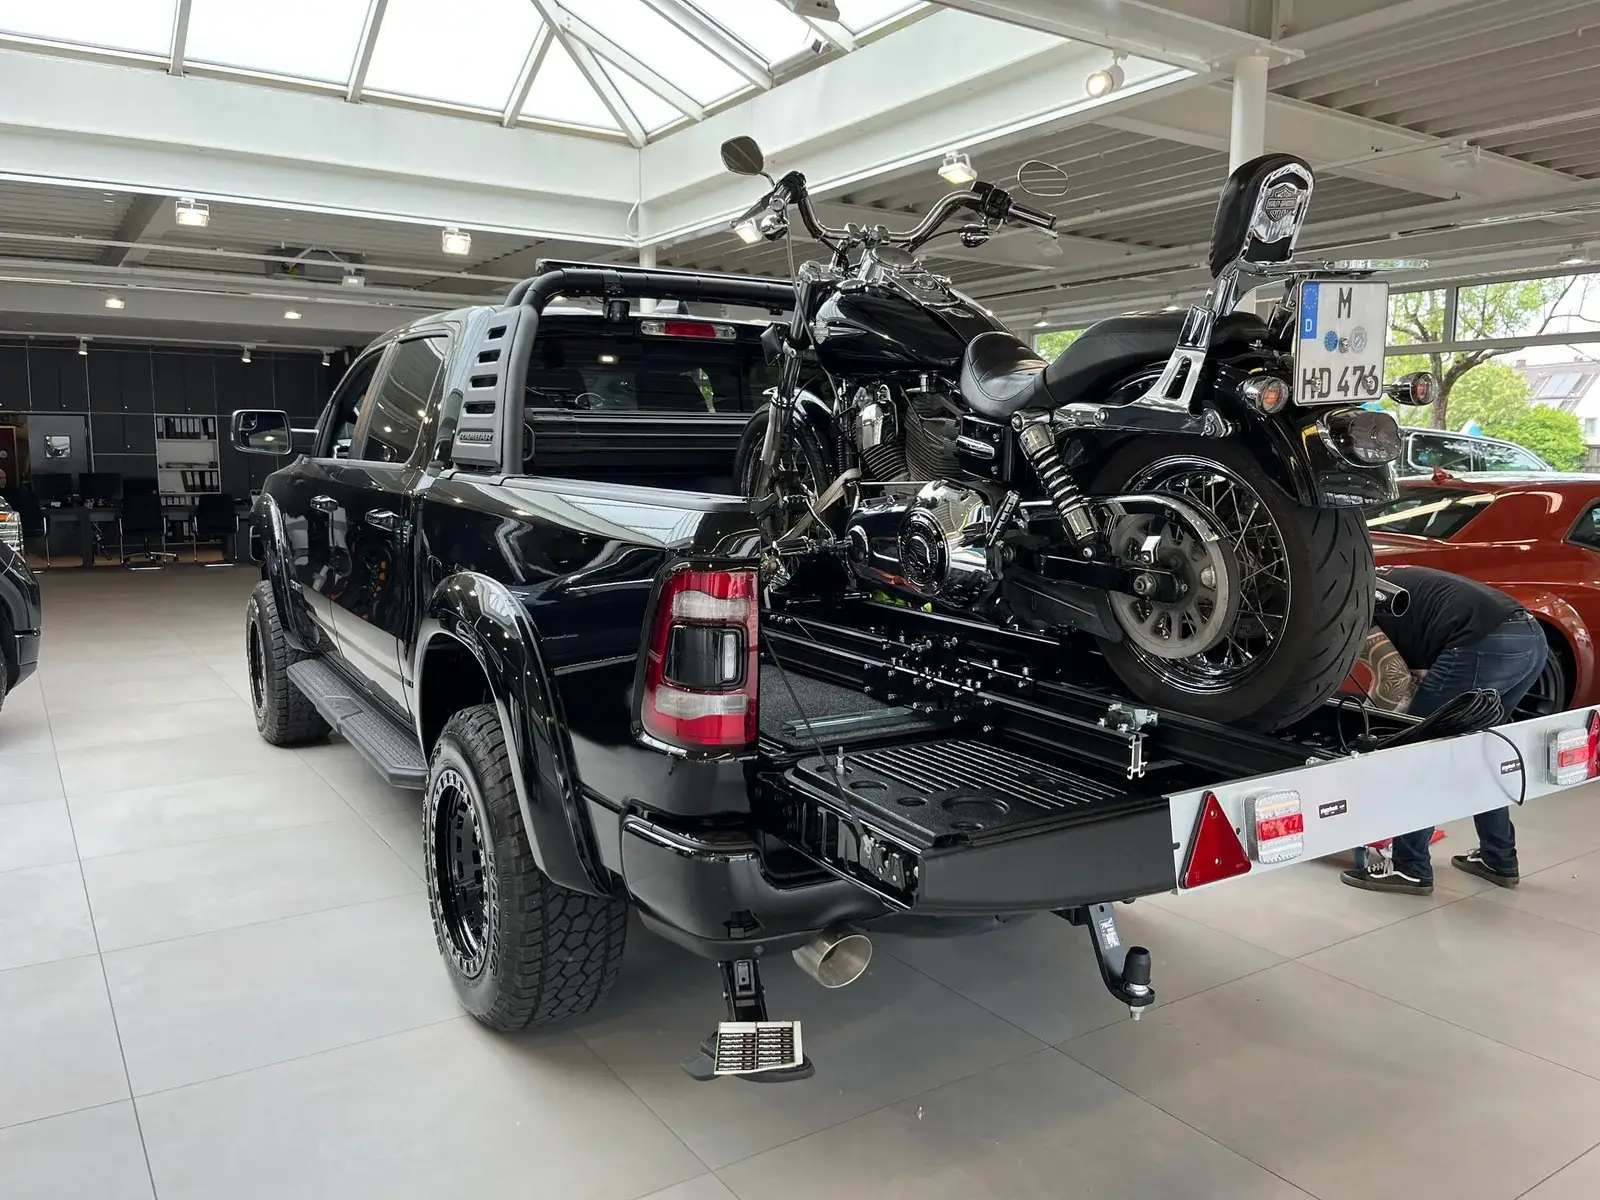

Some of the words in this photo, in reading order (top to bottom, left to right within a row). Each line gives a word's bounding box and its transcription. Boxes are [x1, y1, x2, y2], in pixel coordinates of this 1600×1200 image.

[1337, 287, 1353, 319] M
[1305, 318, 1313, 332] D
[1301, 367, 1332, 400] HD
[1337, 364, 1379, 397] 476
